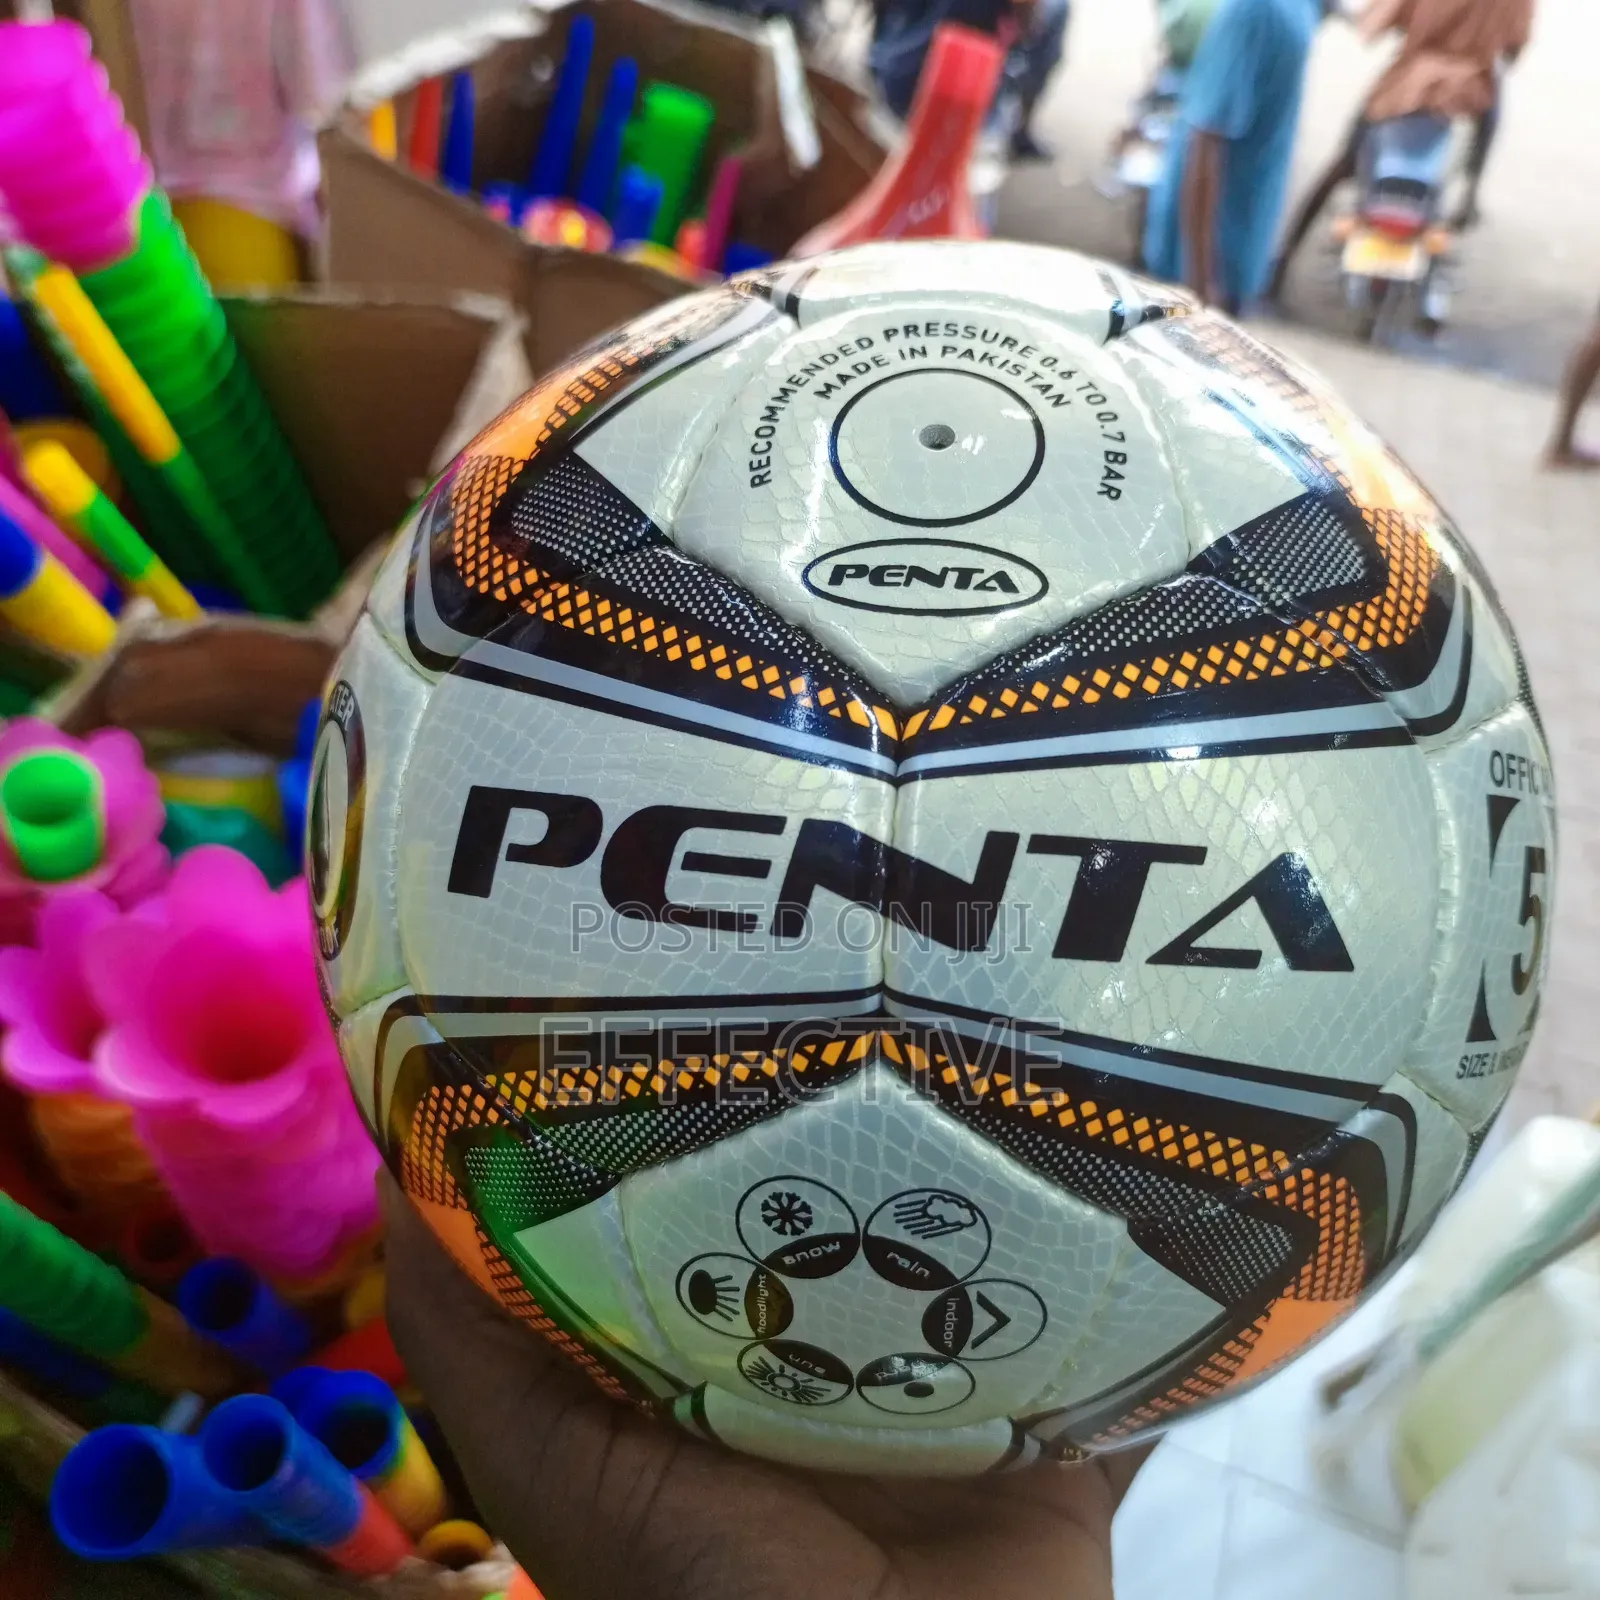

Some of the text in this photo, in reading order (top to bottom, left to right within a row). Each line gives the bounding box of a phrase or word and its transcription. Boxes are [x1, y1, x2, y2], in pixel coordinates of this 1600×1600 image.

[749, 322, 1128, 501] RECOMMENDED PRESSURE 0.6 TO 0.7 BAR
[813, 345, 1071, 409] MADE IN PAKISTAN
[827, 563, 1021, 594] PENTA
[447, 784, 1355, 972] PENTA
[1510, 846, 1546, 996] 5
[1456, 1053, 1490, 1079] SIZE
